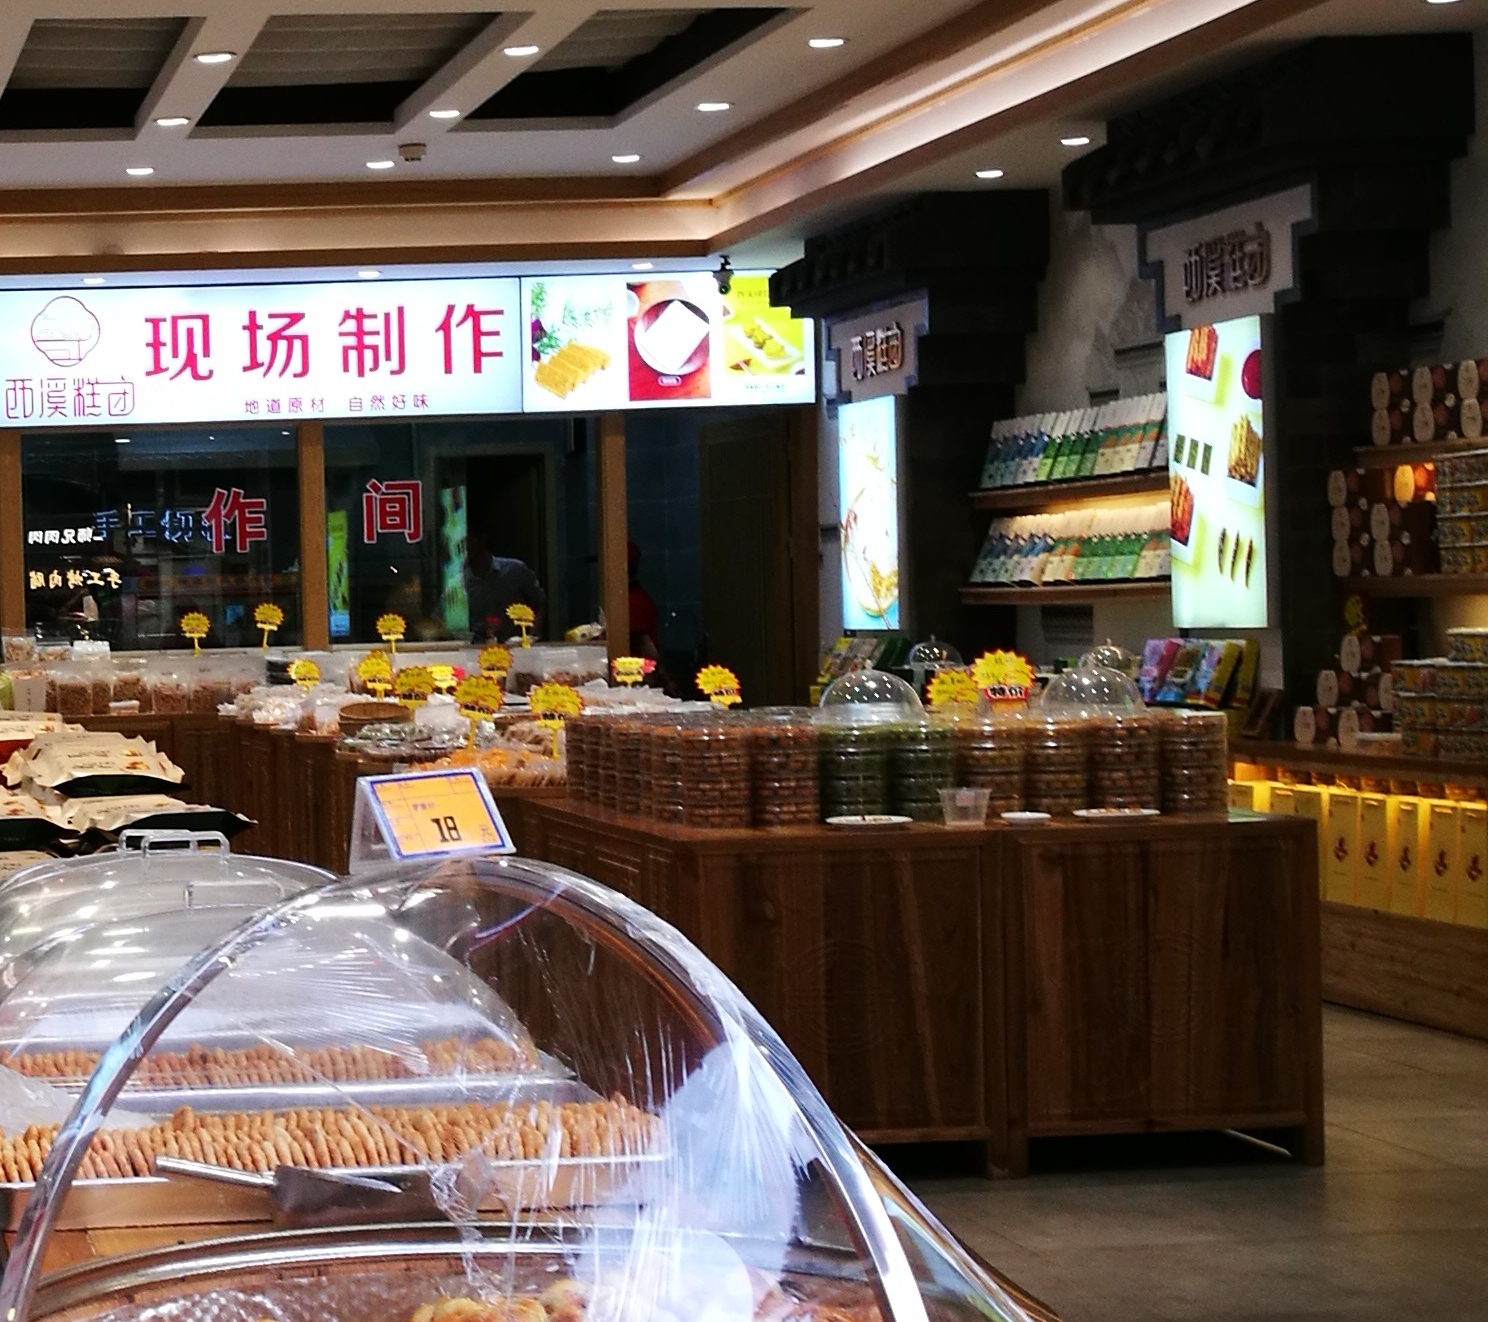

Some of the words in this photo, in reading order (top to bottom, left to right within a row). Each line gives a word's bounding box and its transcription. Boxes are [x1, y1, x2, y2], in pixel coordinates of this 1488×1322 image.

[144, 302, 504, 382] 现场制作
[5, 375, 135, 420] 西溪糕团
[244, 398, 326, 415] 地道原材
[348, 394, 430, 413] 自然好味
[431, 816, 462, 843] 18
